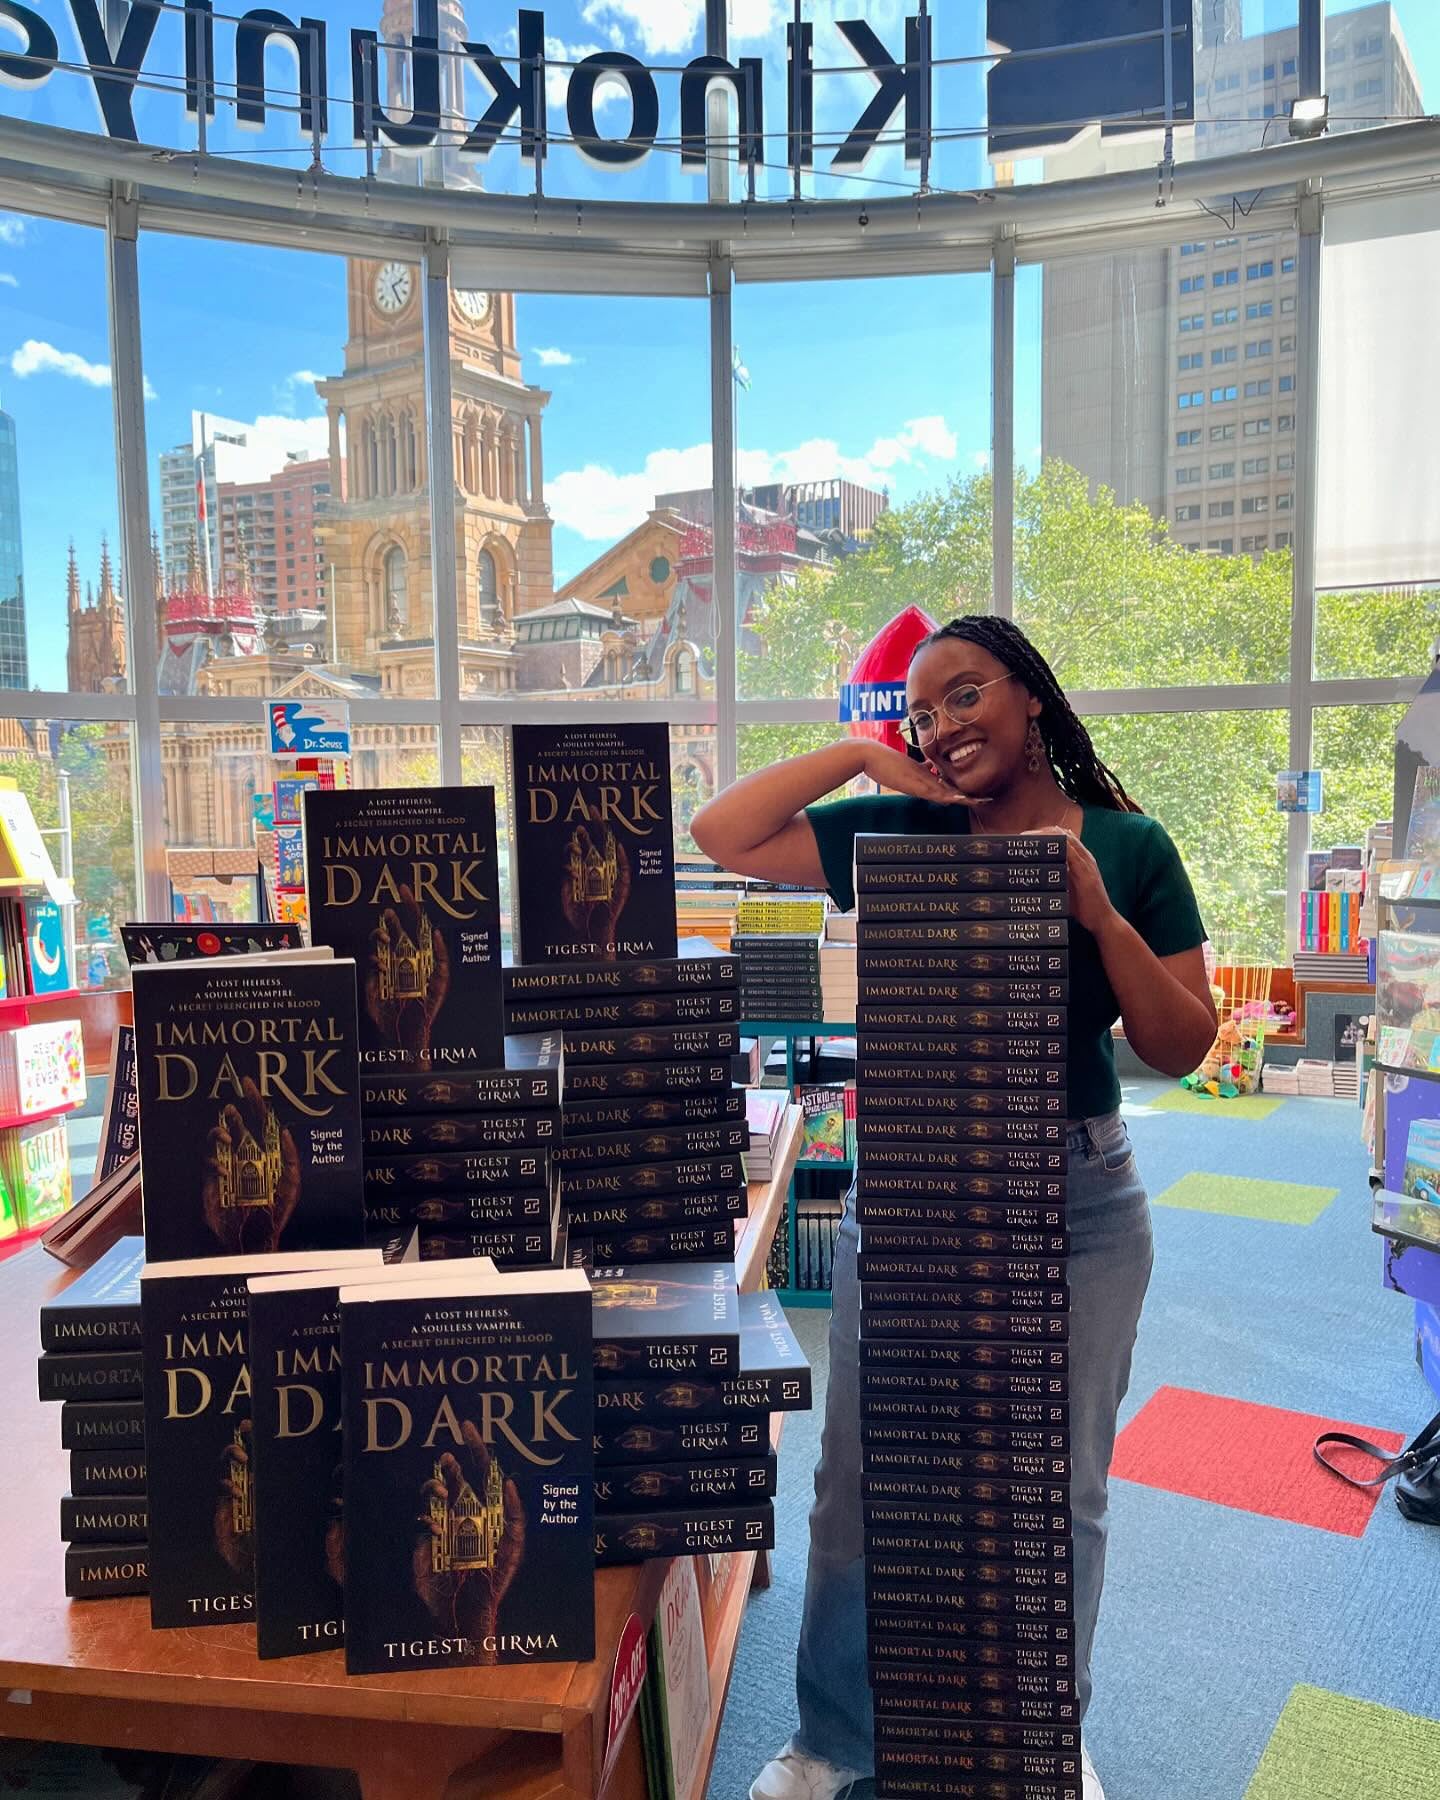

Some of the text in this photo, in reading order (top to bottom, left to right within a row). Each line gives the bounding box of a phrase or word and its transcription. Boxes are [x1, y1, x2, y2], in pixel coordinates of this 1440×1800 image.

[859, 690, 906, 712] TINT
[304, 737, 343, 750] Dr. Seuss
[528, 763, 661, 783] IMMORTAL
[366, 808, 405, 816] SOULLESS
[527, 785, 664, 836] DARK
[344, 820, 373, 828] SECRET
[376, 818, 422, 826] DRENCHED
[437, 817, 466, 825] BLOOD
[324, 832, 486, 858] IMMORTAL
[1006, 840, 1040, 848] TIGEST
[639, 849, 662, 860] Signed
[863, 844, 957, 857] IMMORTAL DARK
[1007, 848, 1040, 858] GIRMA
[640, 858, 662, 867] by the
[639, 867, 663, 875] Author
[323, 860, 489, 919] DARK
[461, 932, 489, 943] Signed
[463, 943, 489, 953] by the
[544, 941, 654, 955] TIGEST GIRMA
[462, 953, 490, 963] Author
[676, 963, 712, 973] TIGEST
[215, 979, 239, 987] LOST
[512, 971, 621, 988] IMMORTAL DARK
[678, 973, 712, 984] GIRMA
[204, 991, 249, 999] SOULLESS
[179, 1004, 212, 1012] SECRET
[216, 1002, 270, 1011] DRENCHED
[273, 1001, 284, 1009] IN
[287, 1000, 321, 1008] BLOOD
[675, 997, 712, 1007] TIGEST
[511, 1006, 620, 1022] IMMORTAL DARK
[677, 1007, 710, 1018] GIRMA
[1007, 1011, 1040, 1020] TIGEST
[864, 1014, 958, 1027] IMMORTAL DARK
[1007, 1020, 1040, 1030] GIRMA
[155, 1017, 344, 1046] IMMORTAL
[672, 1031, 710, 1041] TIGEST
[581, 1040, 616, 1054] DARK
[674, 1042, 709, 1052] GIRMA
[357, 1048, 477, 1063] IGEST GIRMA
[665, 1066, 701, 1075] TIGEST
[155, 1049, 348, 1116] DARK
[476, 1078, 522, 1089] TIGEST
[573, 1075, 608, 1090] DARK
[666, 1076, 701, 1086] GIRMA
[366, 1088, 408, 1105] DARK
[478, 1091, 521, 1102] GIRMA
[801, 1091, 830, 1107] ASTRID
[481, 1118, 527, 1128] TIGEST
[310, 1129, 343, 1142] Signed
[371, 1128, 412, 1144] DARK
[483, 1130, 526, 1143] GIRMA
[312, 1141, 343, 1153] by the
[311, 1154, 345, 1164] Author
[465, 1157, 511, 1167] TIGEST
[466, 1169, 509, 1181] GIRMA
[683, 1195, 719, 1205] TIGEST
[593, 1208, 628, 1223] DARK
[685, 1206, 718, 1217] GIRMA
[864, 1207, 958, 1222] IMMORTAL DARK
[1006, 1208, 1039, 1216] TIGEST
[1006, 1216, 1039, 1227] GIRMA
[424, 1312, 431, 1320] A
[435, 1311, 462, 1320] LOST
[1009, 1316, 1043, 1325] TIGEST
[54, 1321, 142, 1337] IMMORTA
[411, 1325, 418, 1334] A
[421, 1323, 472, 1333] SOULLESS
[868, 1318, 961, 1332] IMMORTAL DARK
[1010, 1325, 1043, 1334] GIRMA
[381, 1334, 553, 1350] A SECRET DRENCHED IN BLOOD
[770, 1331, 793, 1358] TIGEST
[647, 1345, 698, 1355] TIGEST
[649, 1358, 697, 1371] GIRMA
[364, 1353, 578, 1390] IMMORTAL
[722, 1379, 771, 1391] TIGEST
[597, 1391, 645, 1411] DARK
[724, 1393, 770, 1407] GIRMA
[361, 1389, 582, 1466] DARK
[543, 1484, 579, 1497] Signed
[869, 1482, 962, 1498] IMMORTAL DARK
[1010, 1485, 1044, 1495] TIGEST
[543, 1499, 577, 1511] by the
[1011, 1494, 1043, 1504] GIRMA
[75, 1514, 147, 1528] IMMORT
[540, 1513, 579, 1524] Author
[684, 1519, 735, 1532] TIGEST
[686, 1534, 733, 1549] GIRMA
[188, 1594, 254, 1613] TIGES
[384, 1634, 559, 1658] TIGEST GIRMA
[882, 1753, 975, 1770] IMMORTAL DARK
[1023, 1756, 1056, 1765] TIGEST
[1024, 1765, 1055, 1775] GIRMA
